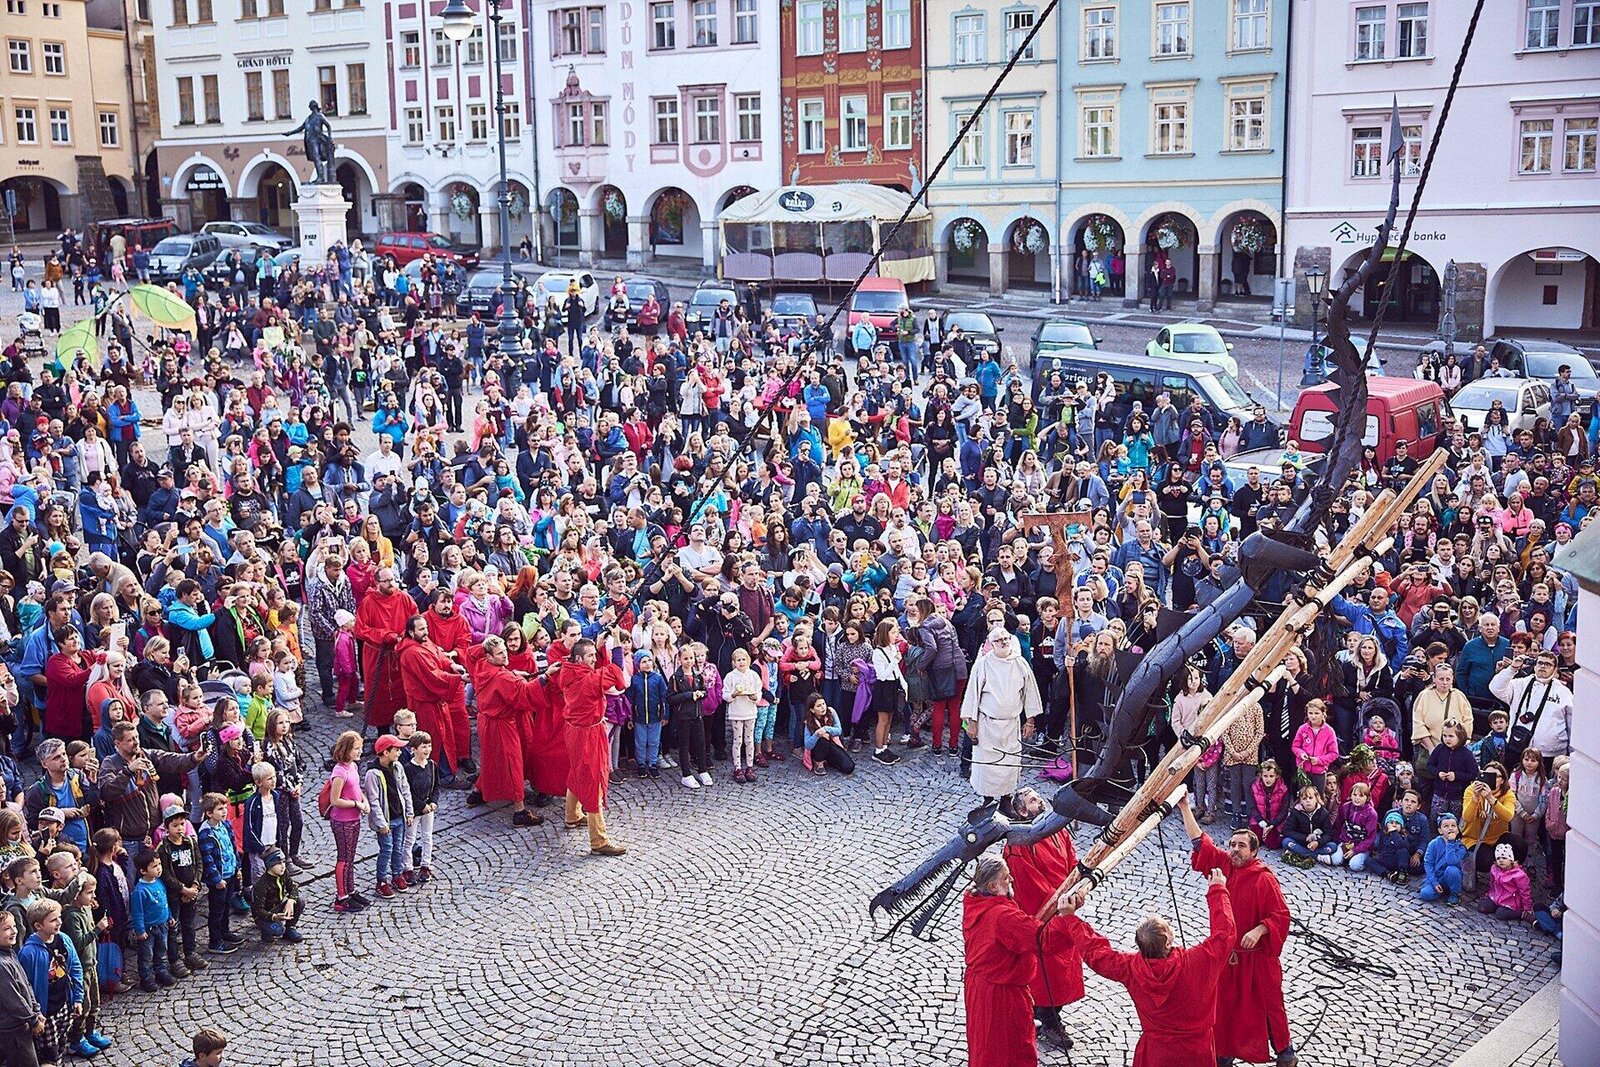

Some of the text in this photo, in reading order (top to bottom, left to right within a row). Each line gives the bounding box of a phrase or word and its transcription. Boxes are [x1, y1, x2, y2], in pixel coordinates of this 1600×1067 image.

[237, 58, 264, 68] GRAND
[622, 82, 636, 172] MÓDY
[1356, 231, 1446, 244] Hypeč banka
